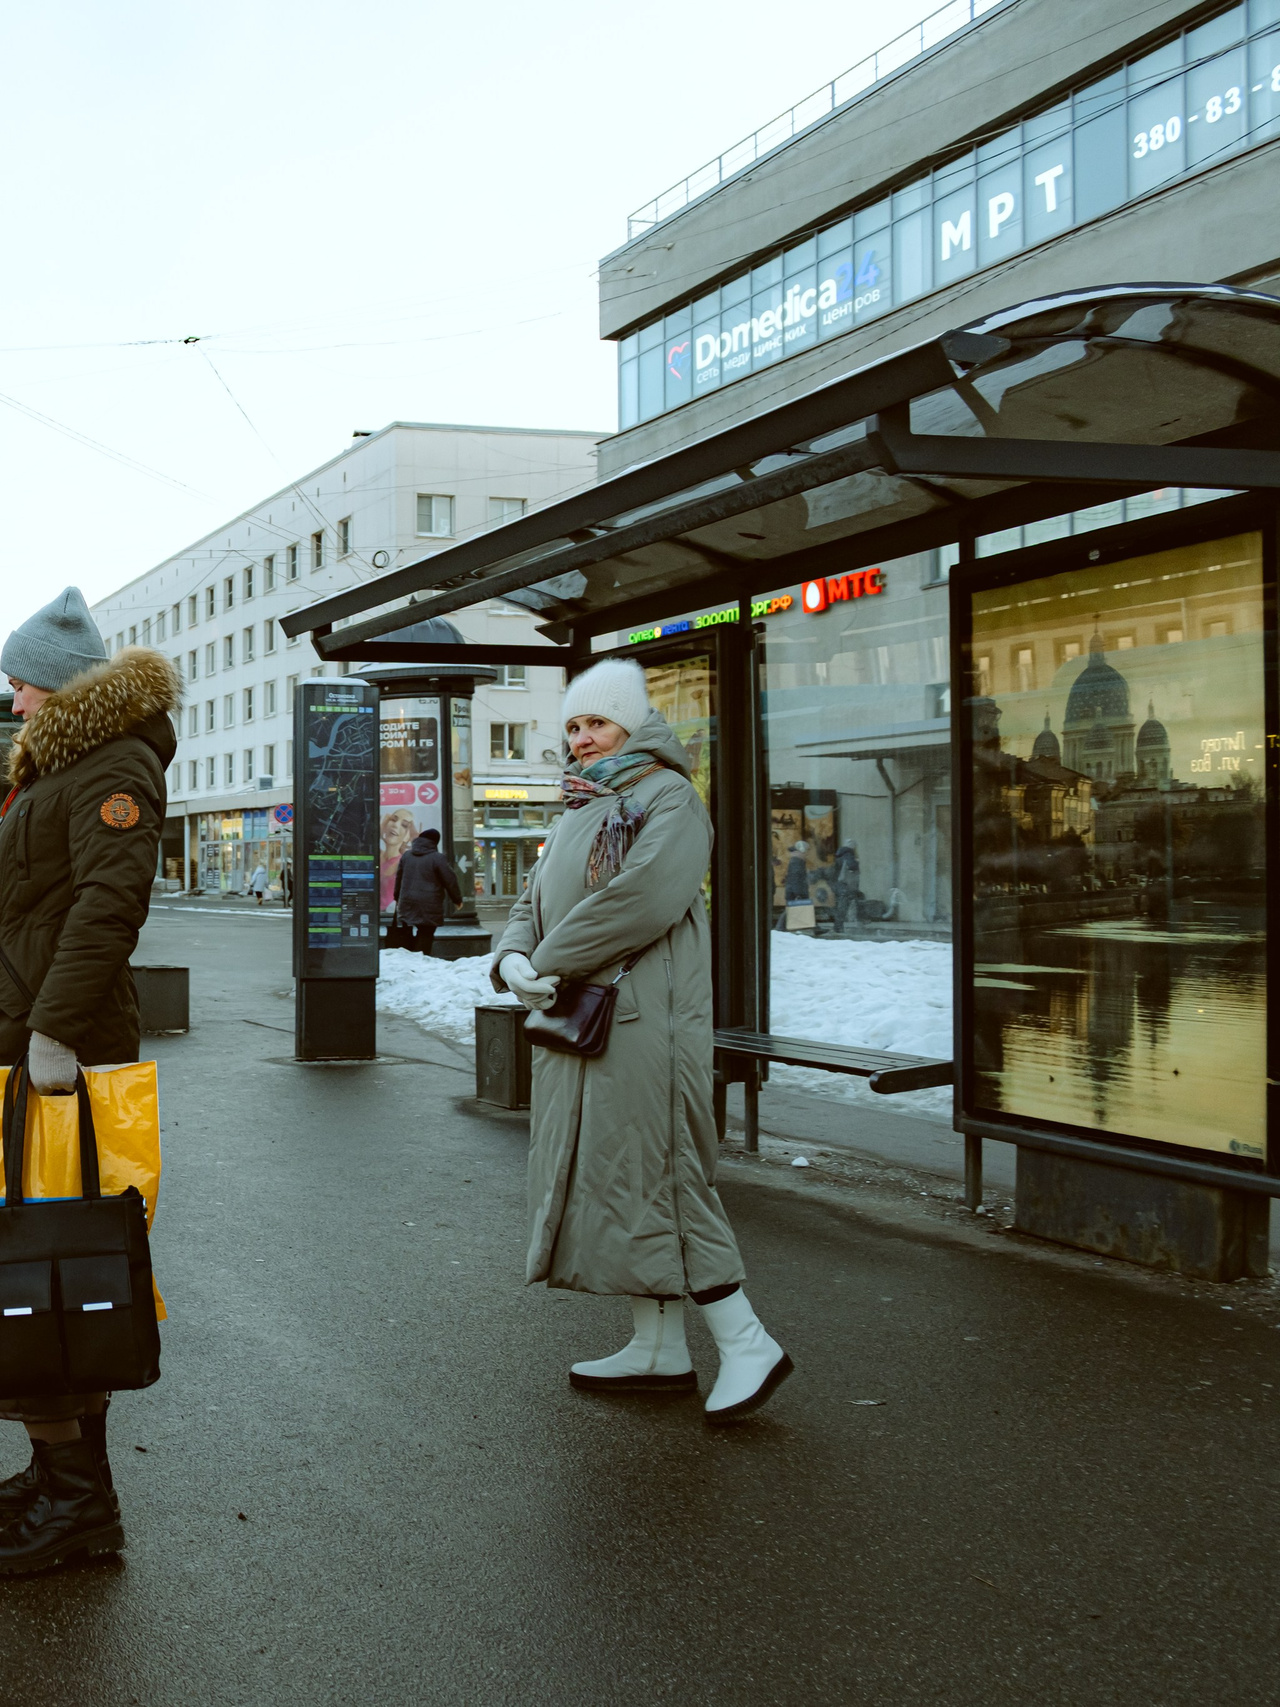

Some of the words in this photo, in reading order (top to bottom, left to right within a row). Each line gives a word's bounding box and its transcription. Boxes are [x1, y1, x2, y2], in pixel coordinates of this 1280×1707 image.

[696, 367, 719, 384] сеть
[822, 289, 881, 326] центров
[828, 568, 883, 604] МТС
[407, 740, 416, 748] И
[419, 739, 434, 748] ГБ
